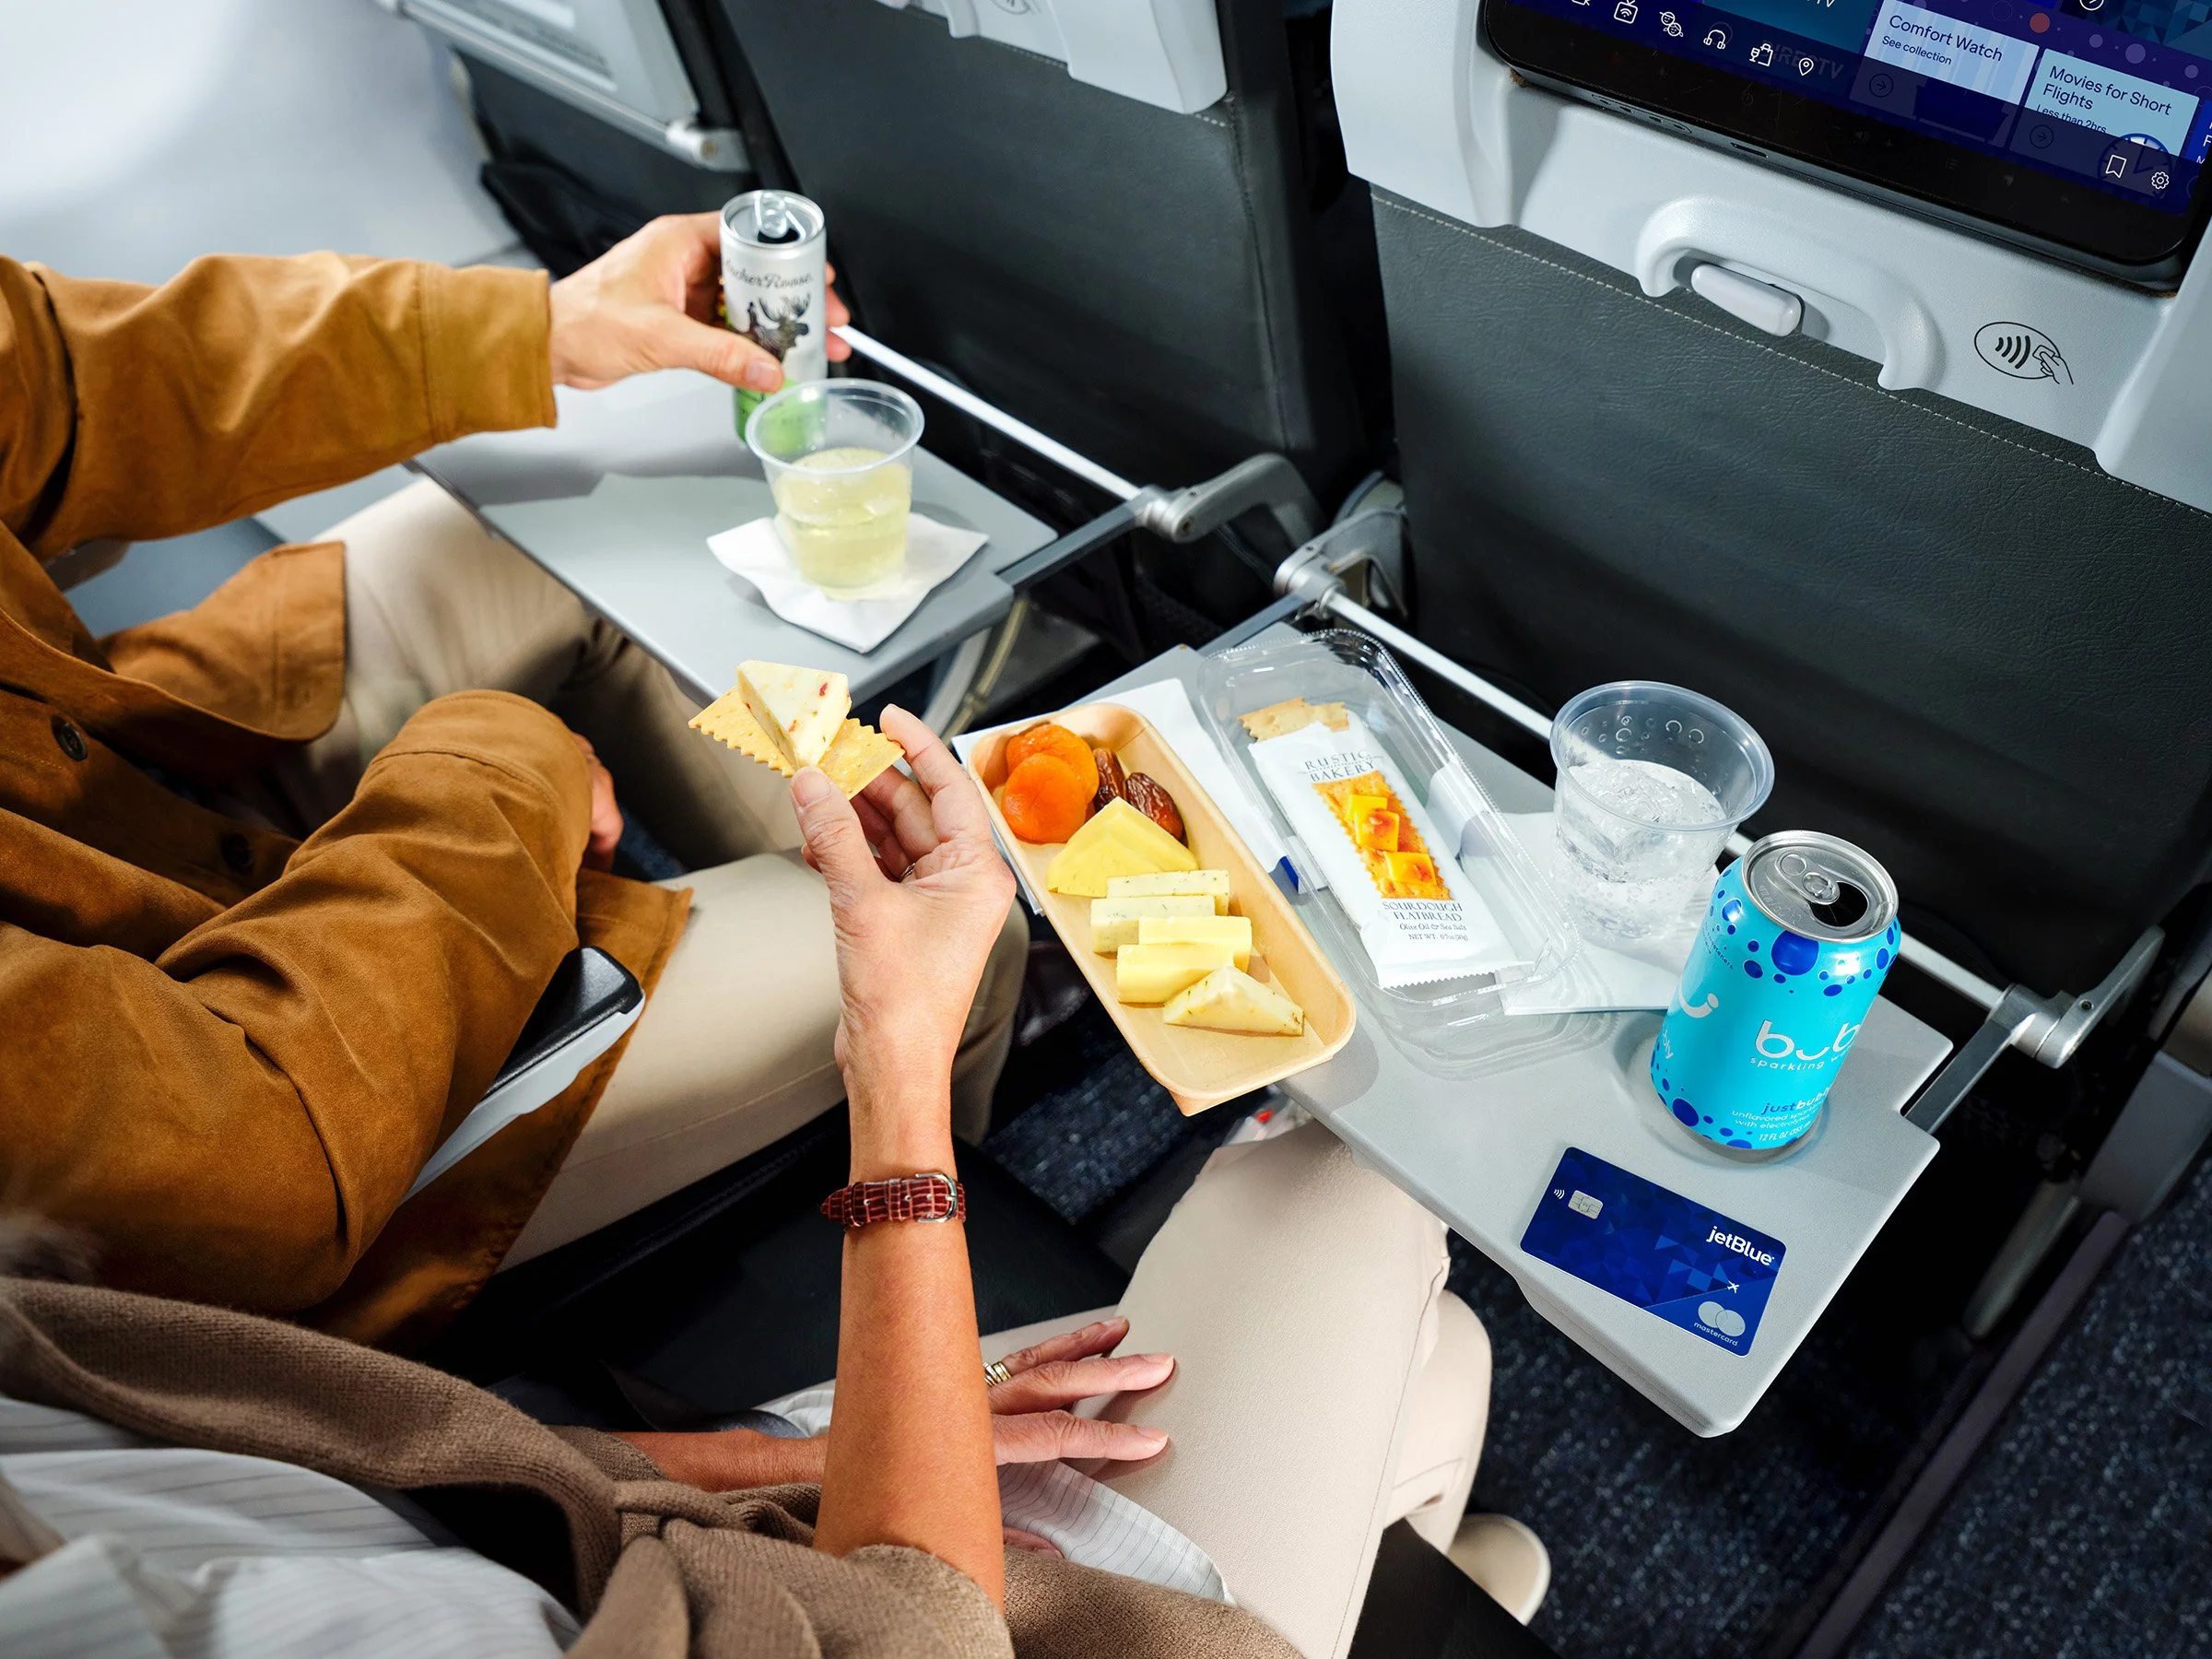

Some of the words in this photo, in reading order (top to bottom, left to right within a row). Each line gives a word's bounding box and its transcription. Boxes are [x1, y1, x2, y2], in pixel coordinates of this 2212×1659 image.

[1889, 15, 1953, 45] Comfort
[1957, 35, 2002, 61] Watch
[1882, 35, 1901, 49] See
[1903, 43, 1952, 65] collection
[2043, 83, 2093, 110] Flights
[2049, 65, 2102, 93] Movies
[2105, 83, 2128, 101] for
[2130, 91, 2172, 116] Short
[2062, 112, 2084, 126] than
[1304, 750, 1370, 771] RUSTIC
[1311, 759, 1374, 782] BAKERY
[1382, 901, 1463, 912] SOURDOUGH
[1394, 911, 1463, 922] FLATBREAD
[1749, 1057, 1825, 1071] sparkling
[1732, 1110, 1788, 1122] unflavored
[1735, 1119, 1758, 1128] with
[1759, 1133, 1768, 1141] 12
[1768, 1132, 1777, 1141] FL
[1706, 1226, 1771, 1266] jetBlue
[1693, 1321, 1738, 1347] mastercard
